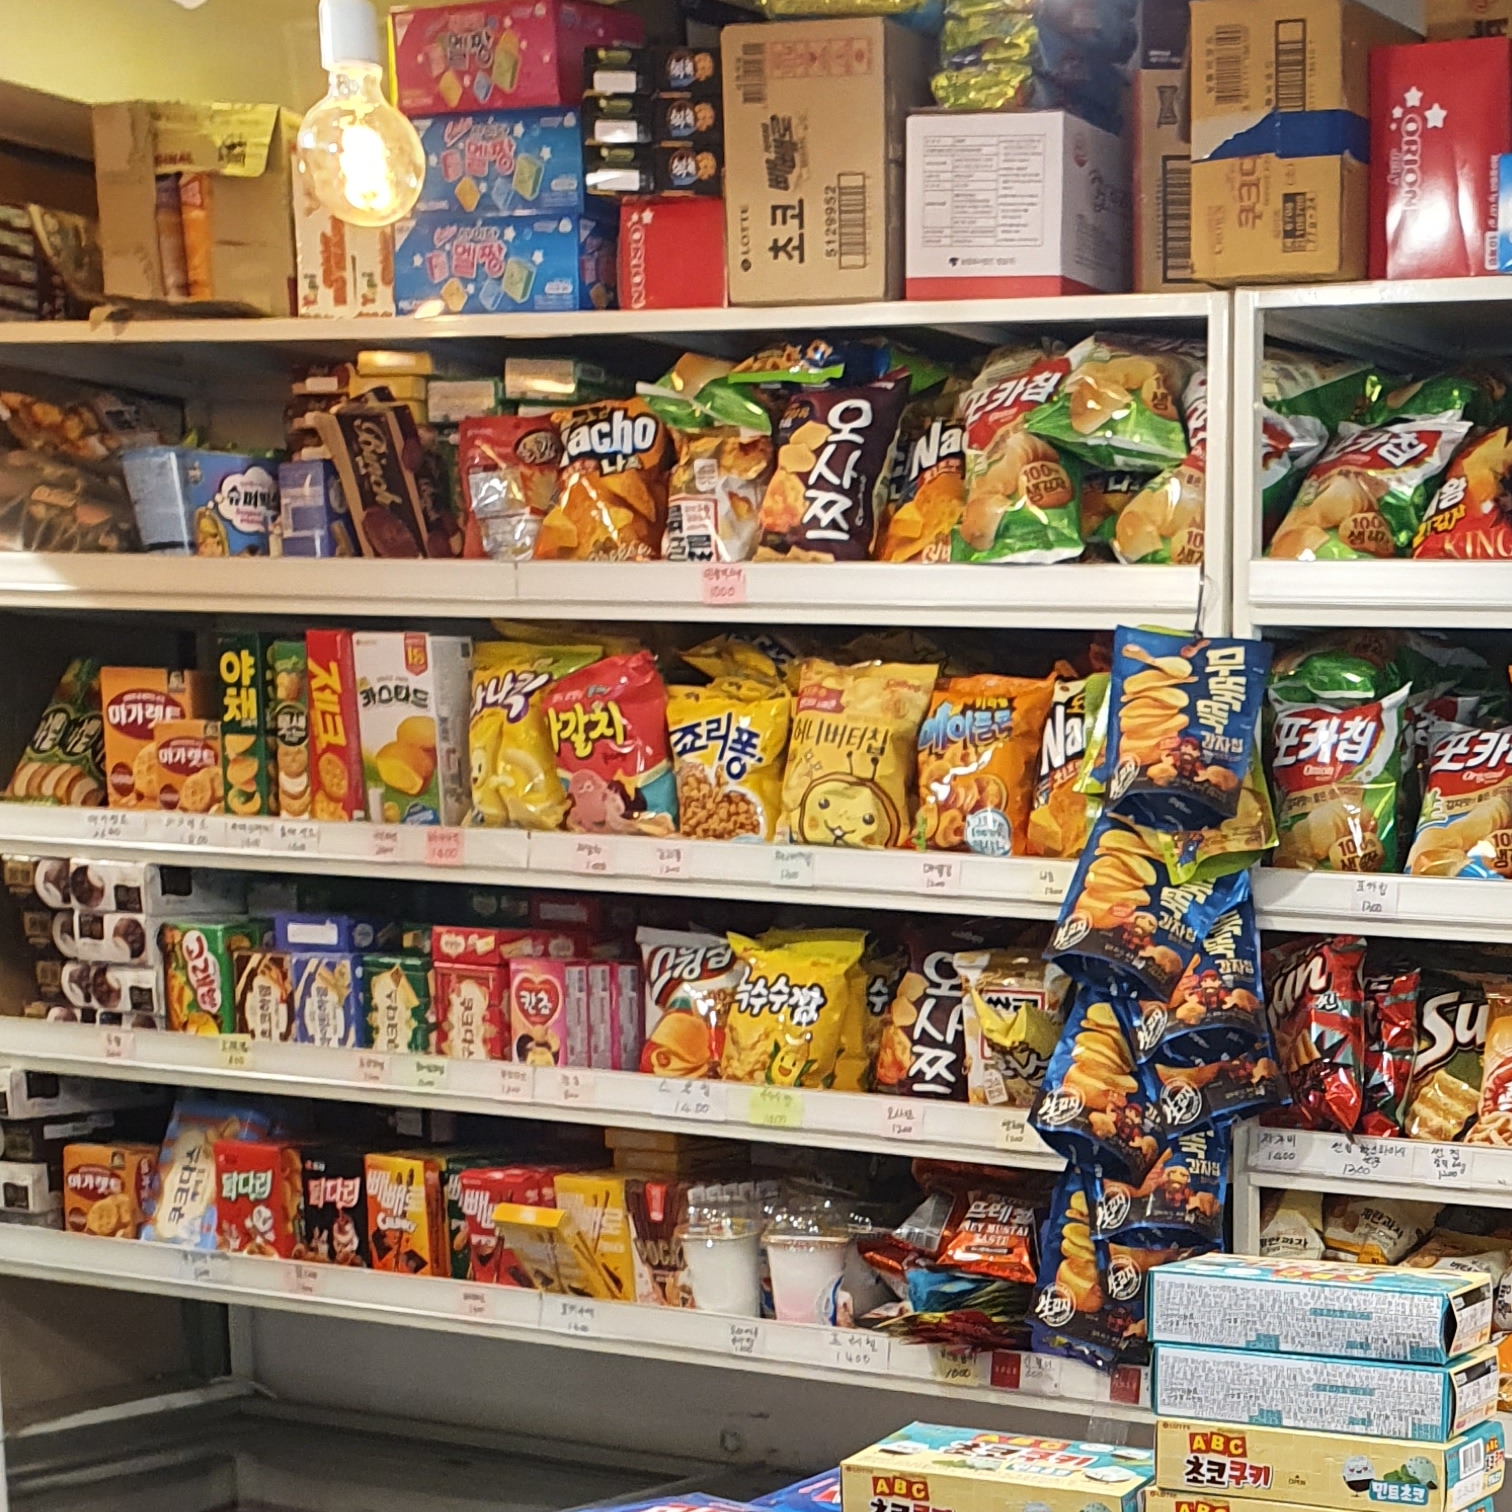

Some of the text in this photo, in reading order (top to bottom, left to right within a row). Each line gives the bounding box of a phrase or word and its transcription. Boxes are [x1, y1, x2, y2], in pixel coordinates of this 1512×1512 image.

[769, 197, 805, 264] 초코
[803, 399, 873, 541] 오사쯔
[220, 649, 259, 726] 야채
[359, 681, 429, 709] 카스타드
[670, 713, 763, 782] 죠리퐁
[1201, 731, 1243, 753] 감자칩
[1272, 712, 1379, 765] 포카칩
[222, 1170, 272, 1200] 닭다리
[308, 1177, 361, 1208] 닭다리
[1189, 1434, 1247, 1456] ABC
[1184, 1455, 1273, 1488] 초코쿠키
[873, 1477, 928, 1499] ABC
[1371, 1482, 1426, 1504] 민트초코
